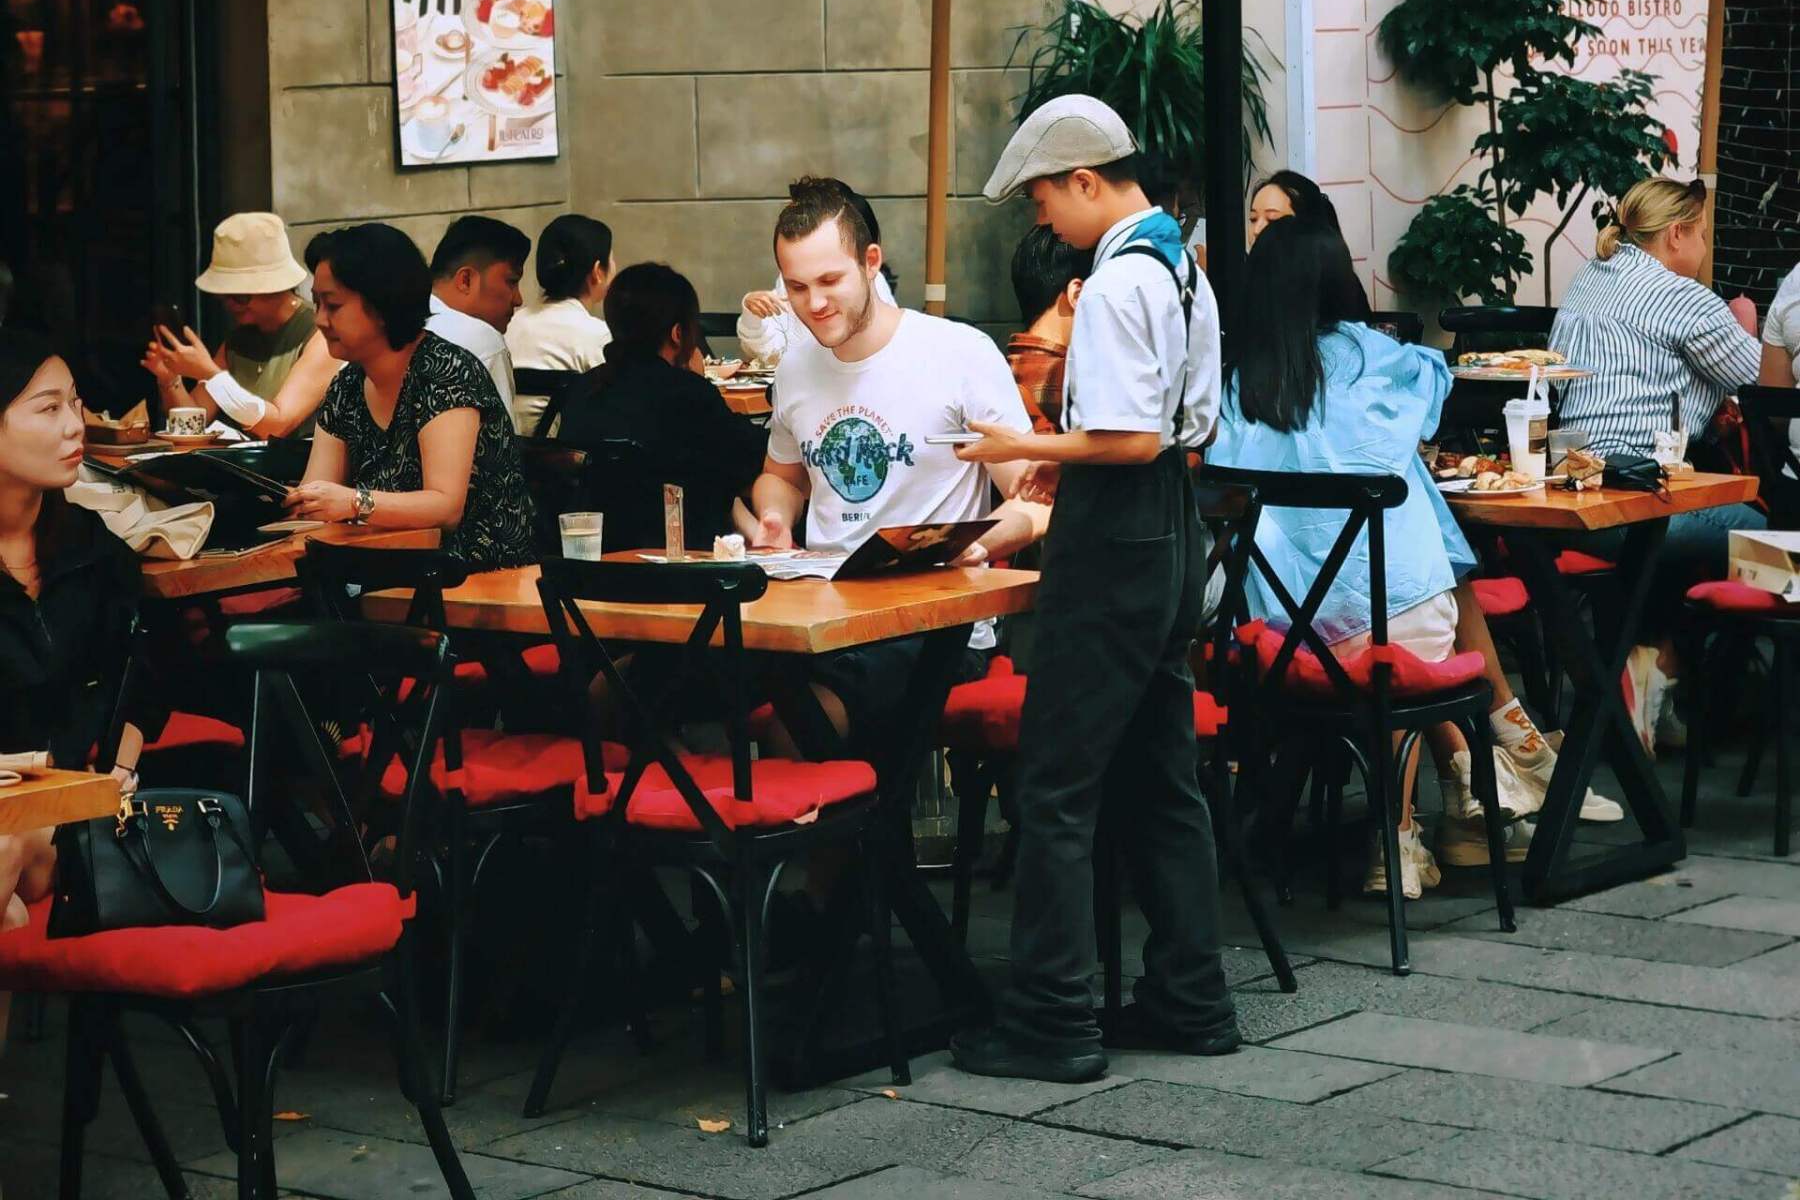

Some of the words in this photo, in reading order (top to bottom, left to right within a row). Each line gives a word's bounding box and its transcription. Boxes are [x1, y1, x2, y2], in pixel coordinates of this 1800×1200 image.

[1628, 0, 1682, 17] BISTRO
[1587, 38, 1630, 57] SOON
[1638, 37, 1673, 55] THIS
[1680, 36, 1706, 54] YEA
[815, 412, 837, 439] SAVE
[837, 405, 856, 418] THE
[800, 435, 852, 468] Hard
[855, 432, 916, 469] Rock
[844, 474, 869, 486] CAFE
